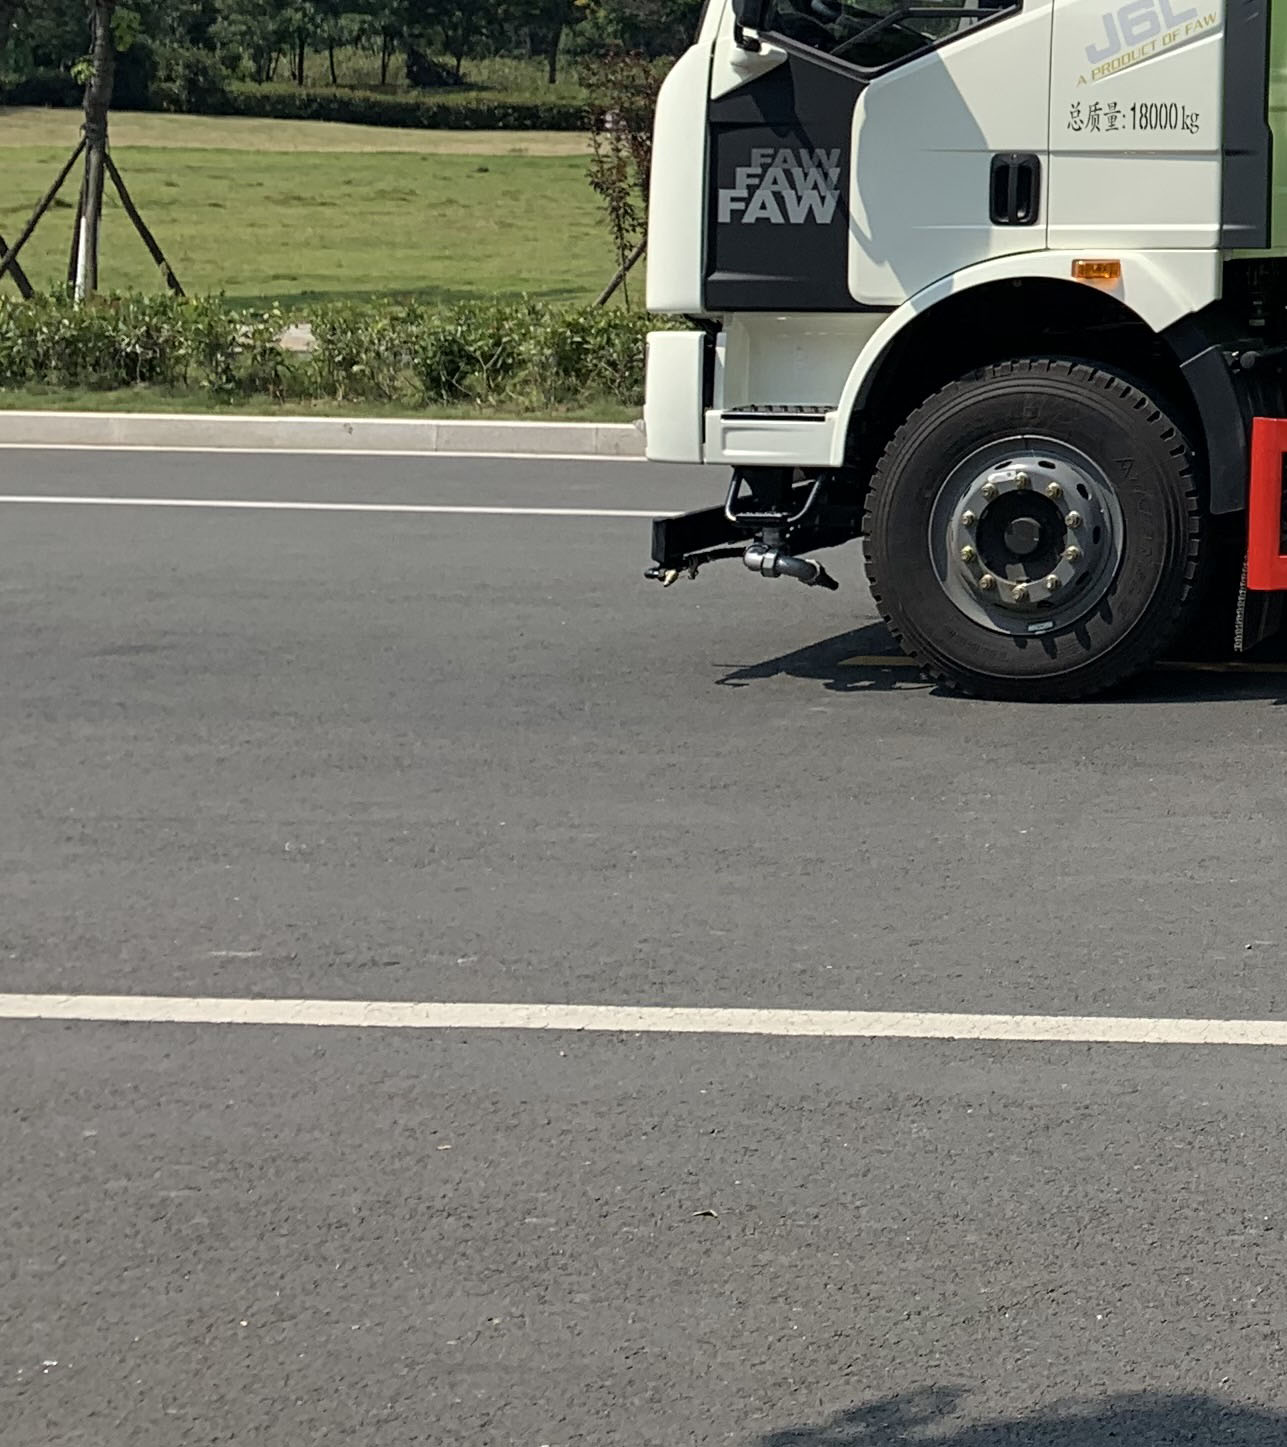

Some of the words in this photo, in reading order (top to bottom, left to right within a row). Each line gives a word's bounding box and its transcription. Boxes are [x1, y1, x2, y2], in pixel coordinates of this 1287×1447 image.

[1076, 75, 1087, 88] A
[1091, 39, 1157, 81] PRODUCT
[1162, 28, 1182, 46] OF
[1184, 11, 1217, 35] FAW
[751, 148, 840, 173] FAW
[735, 167, 840, 196] FAW
[717, 188, 840, 224] FAW
